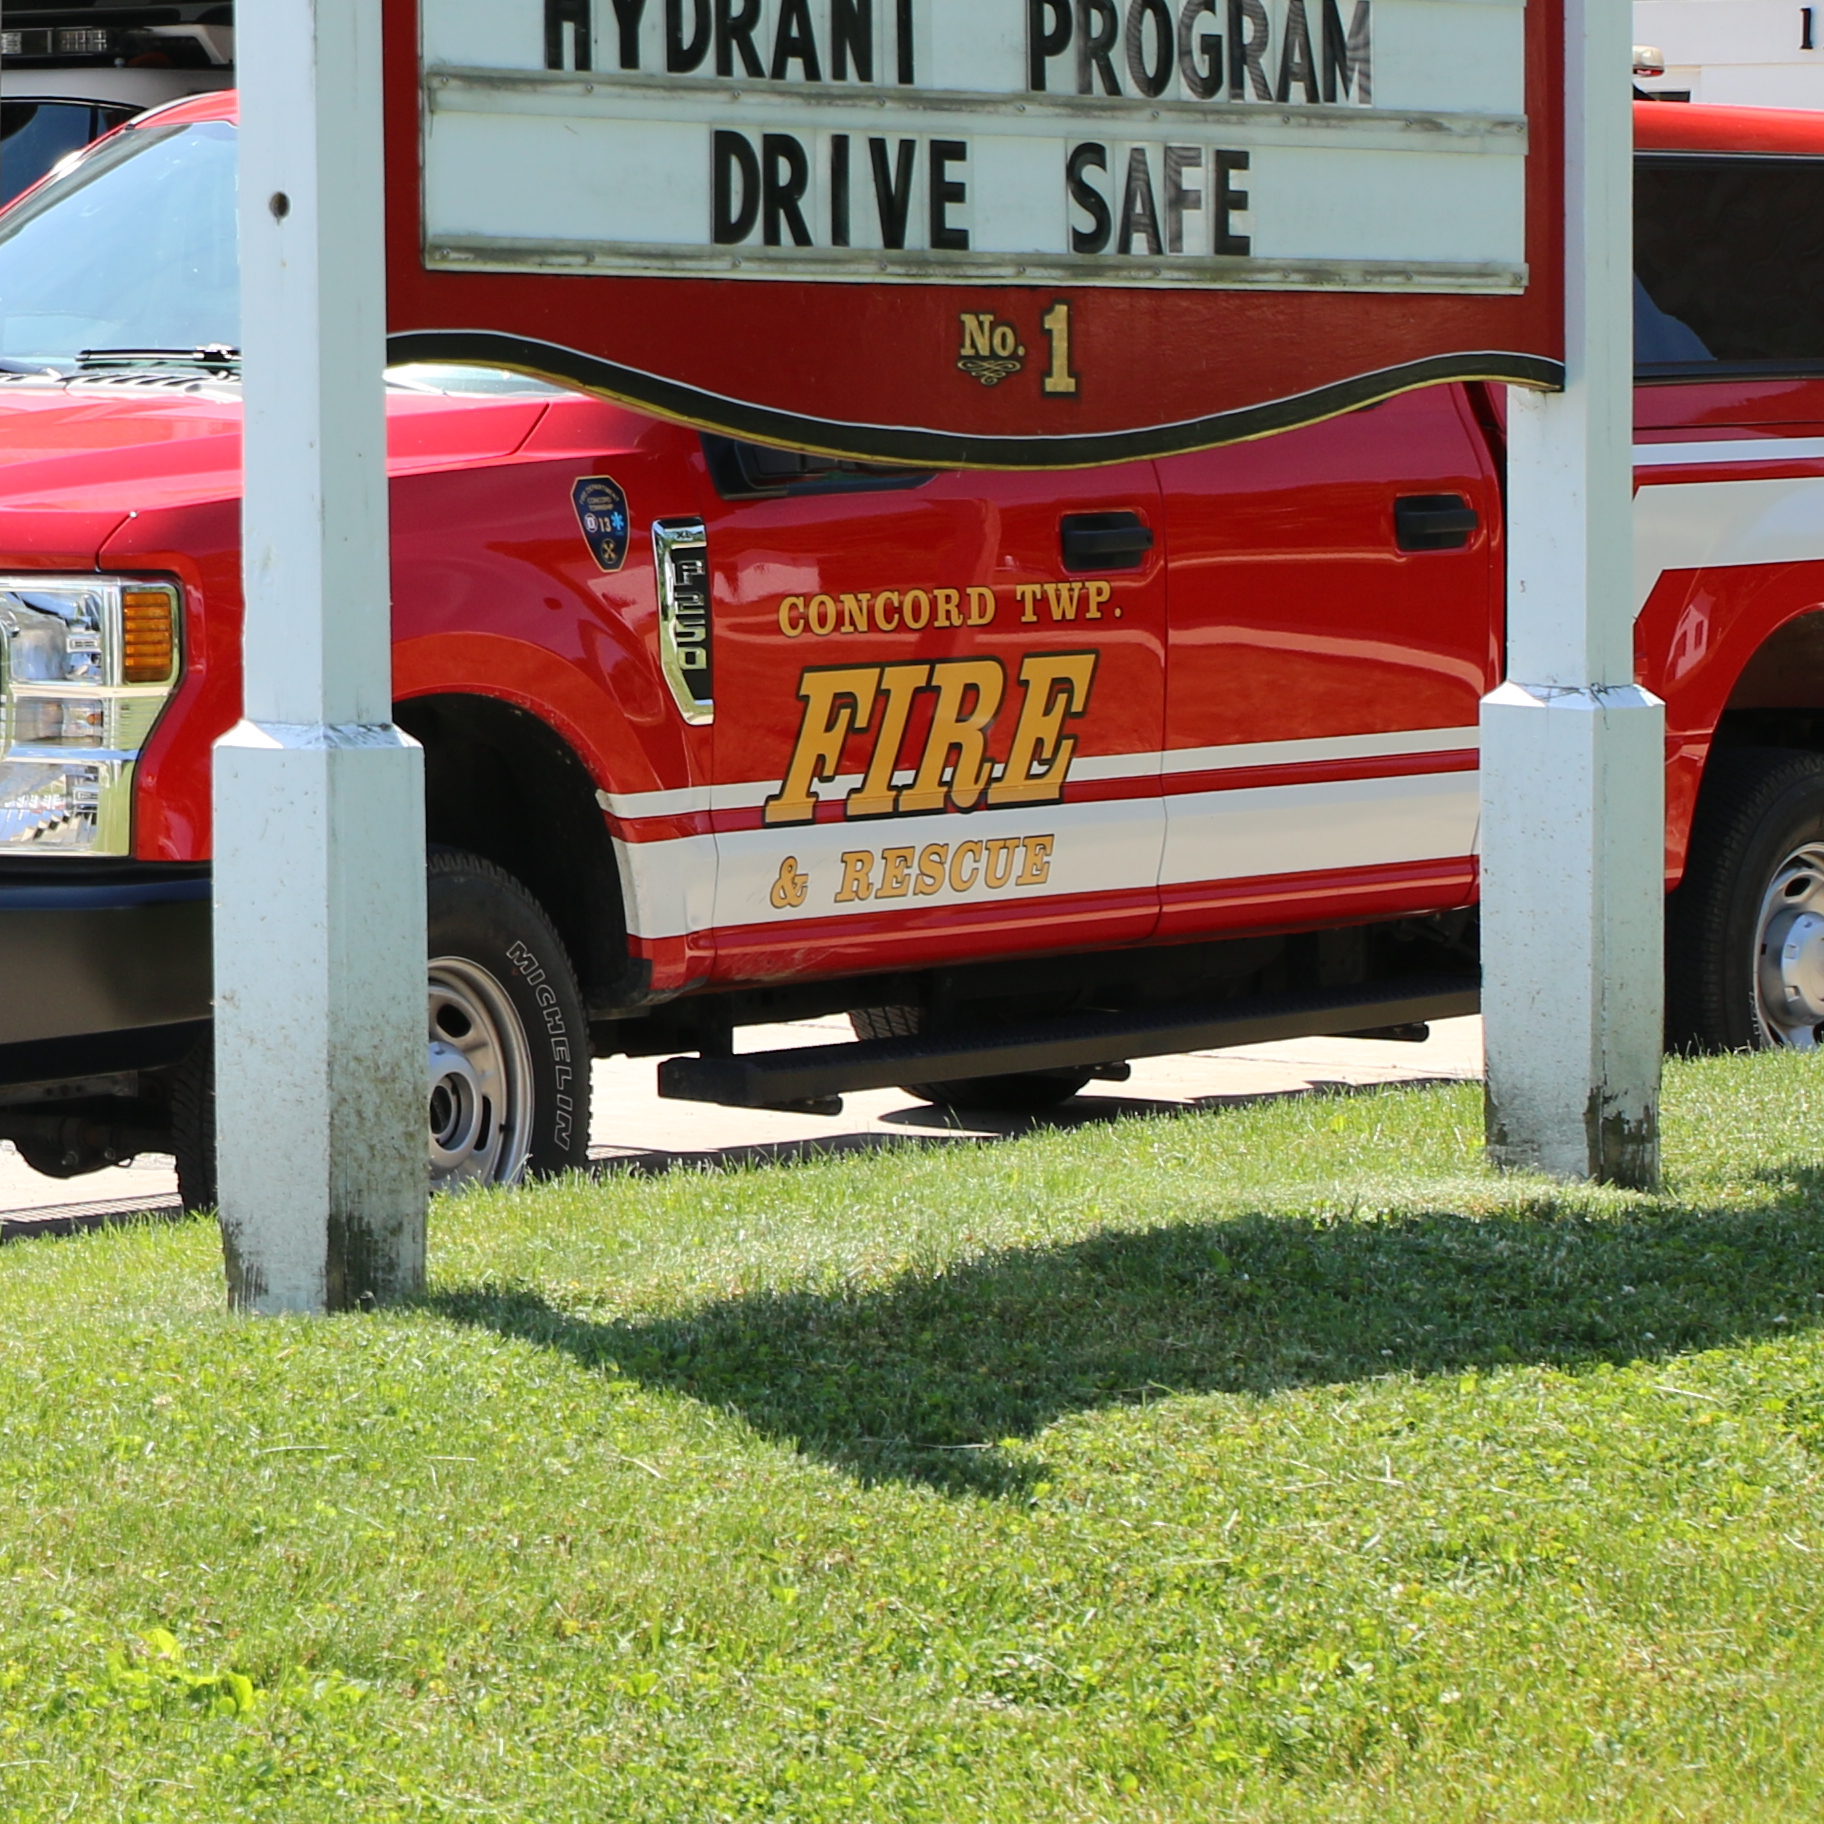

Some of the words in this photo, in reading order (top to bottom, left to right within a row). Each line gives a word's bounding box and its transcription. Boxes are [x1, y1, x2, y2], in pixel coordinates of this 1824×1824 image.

[709, 128, 970, 252] DRIVE
[1066, 140, 1253, 258] SAFE
[959, 312, 1026, 360] No.
[1042, 302, 1077, 394] 1
[777, 585, 998, 639] CONCORD
[1015, 579, 1124, 624] TWP.
[763, 650, 1100, 826] FIRE
[769, 856, 809, 910] &
[833, 833, 1056, 904] RESCUE
[505, 940, 573, 1151] MICHELIN
